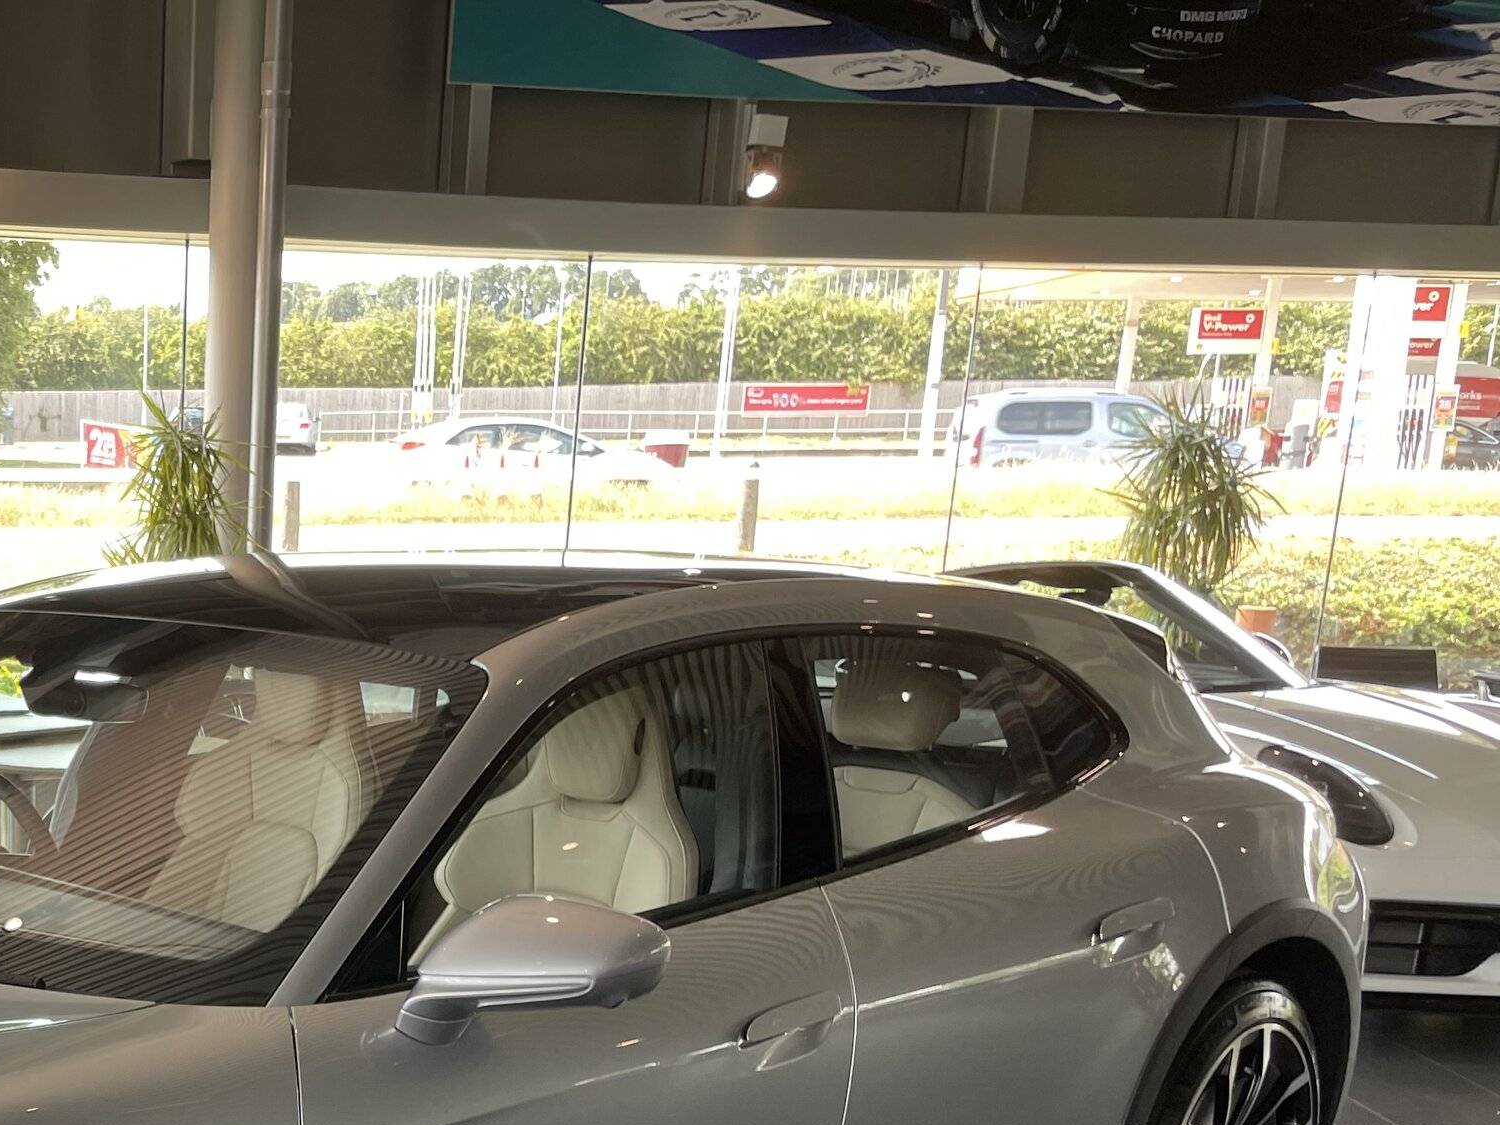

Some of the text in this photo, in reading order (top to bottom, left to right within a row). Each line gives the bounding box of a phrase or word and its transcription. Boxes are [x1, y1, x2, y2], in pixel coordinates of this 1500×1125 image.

[1180, 9, 1216, 22] DMG
[1151, 25, 1225, 43] CHOPARD
[1203, 321, 1250, 332] V-Power
